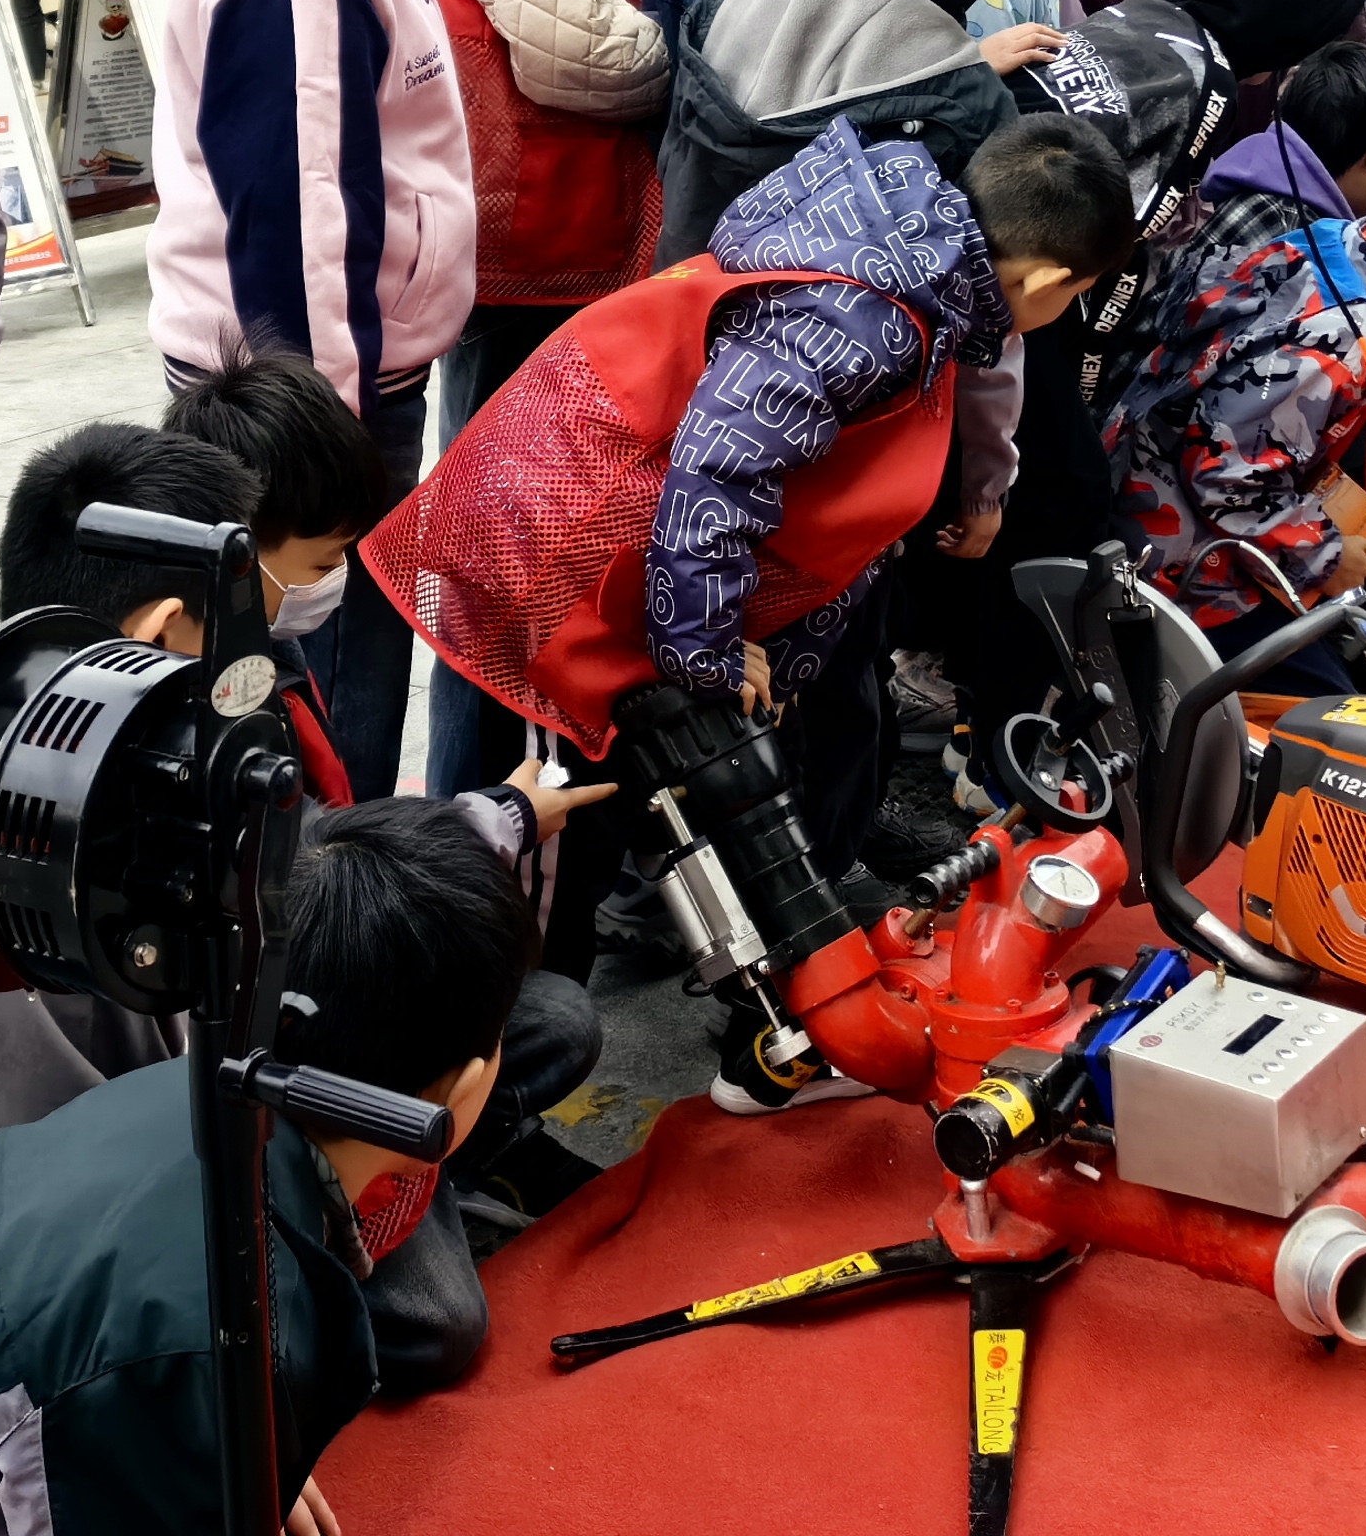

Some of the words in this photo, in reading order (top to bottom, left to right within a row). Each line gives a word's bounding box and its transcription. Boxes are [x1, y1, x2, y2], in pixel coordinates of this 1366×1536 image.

[404, 60, 413, 76] A
[404, 62, 445, 91] Dream
[1188, 89, 1229, 159] DEFINEX
[1094, 272, 1139, 333] DEFINEX
[982, 1385, 1006, 1453] TAILONG
